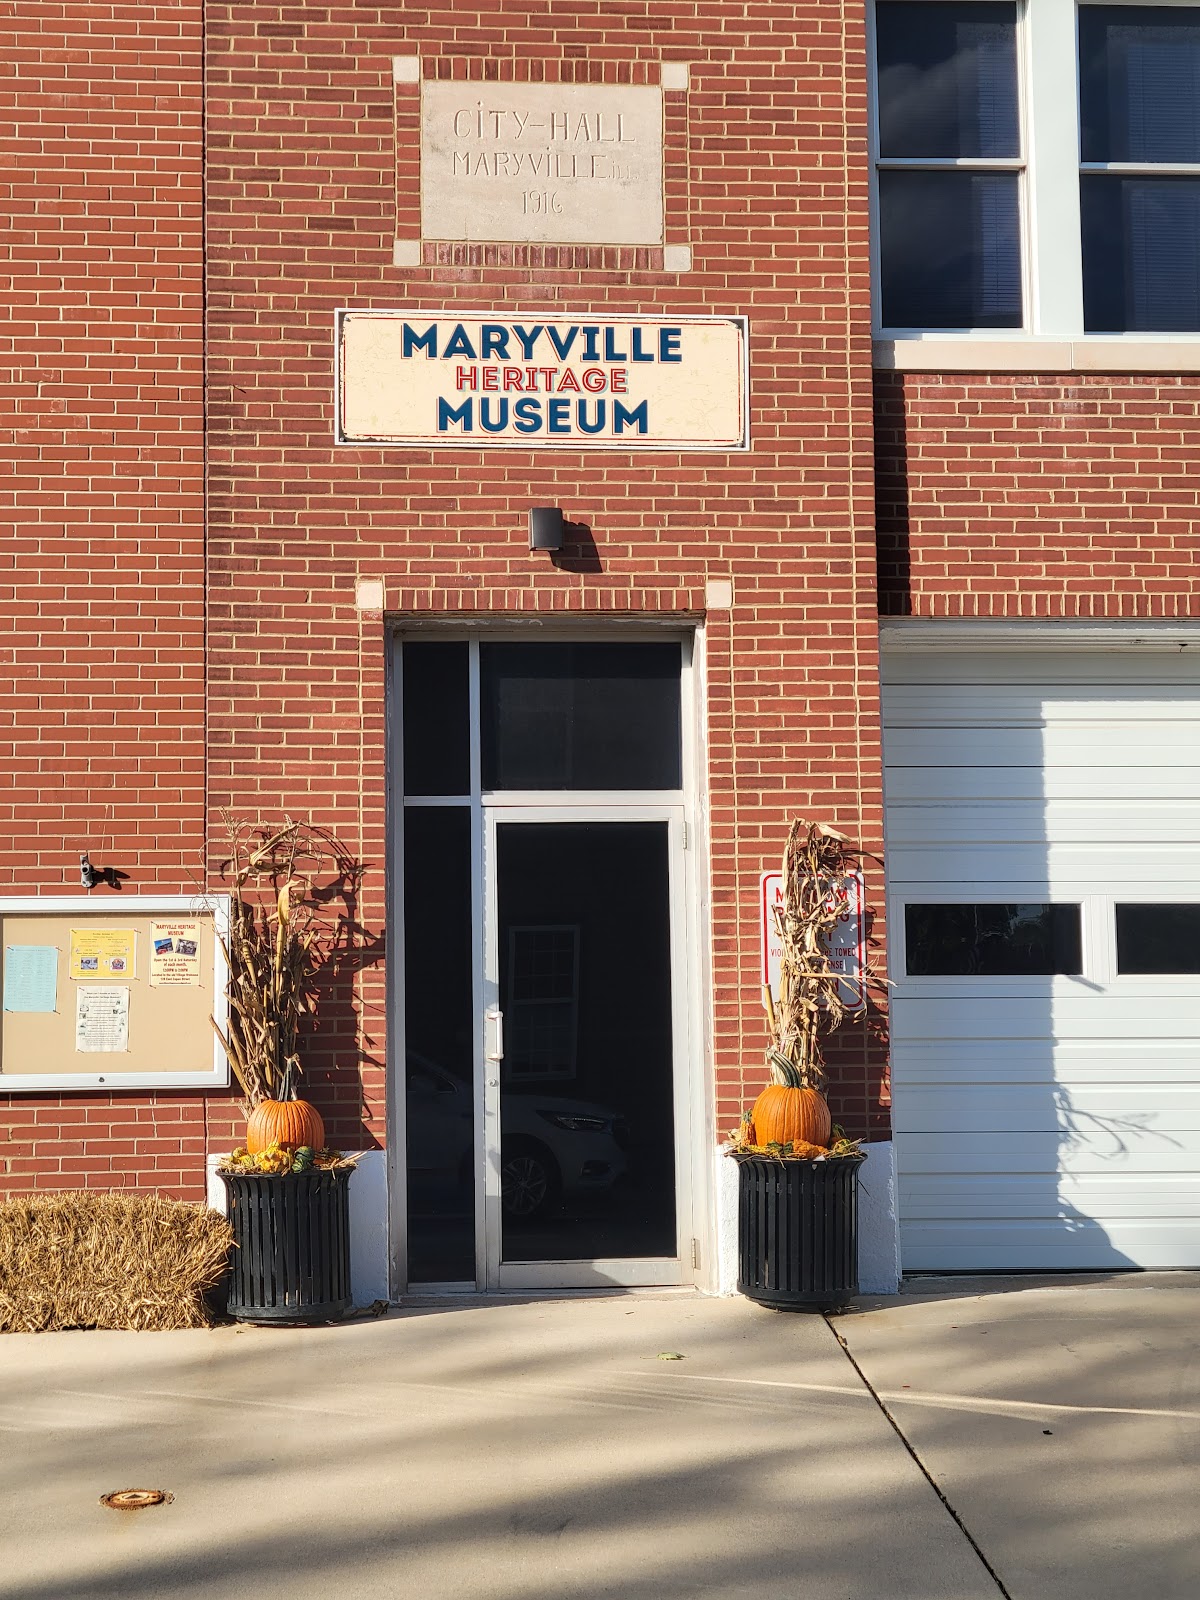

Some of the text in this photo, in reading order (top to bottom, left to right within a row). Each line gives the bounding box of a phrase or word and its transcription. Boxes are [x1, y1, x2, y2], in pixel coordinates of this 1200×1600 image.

[521, 190, 564, 215] 1916
[401, 322, 683, 364] MARYVILLE
[456, 366, 629, 394] HERITAGE
[436, 396, 648, 437] MUSEUM
